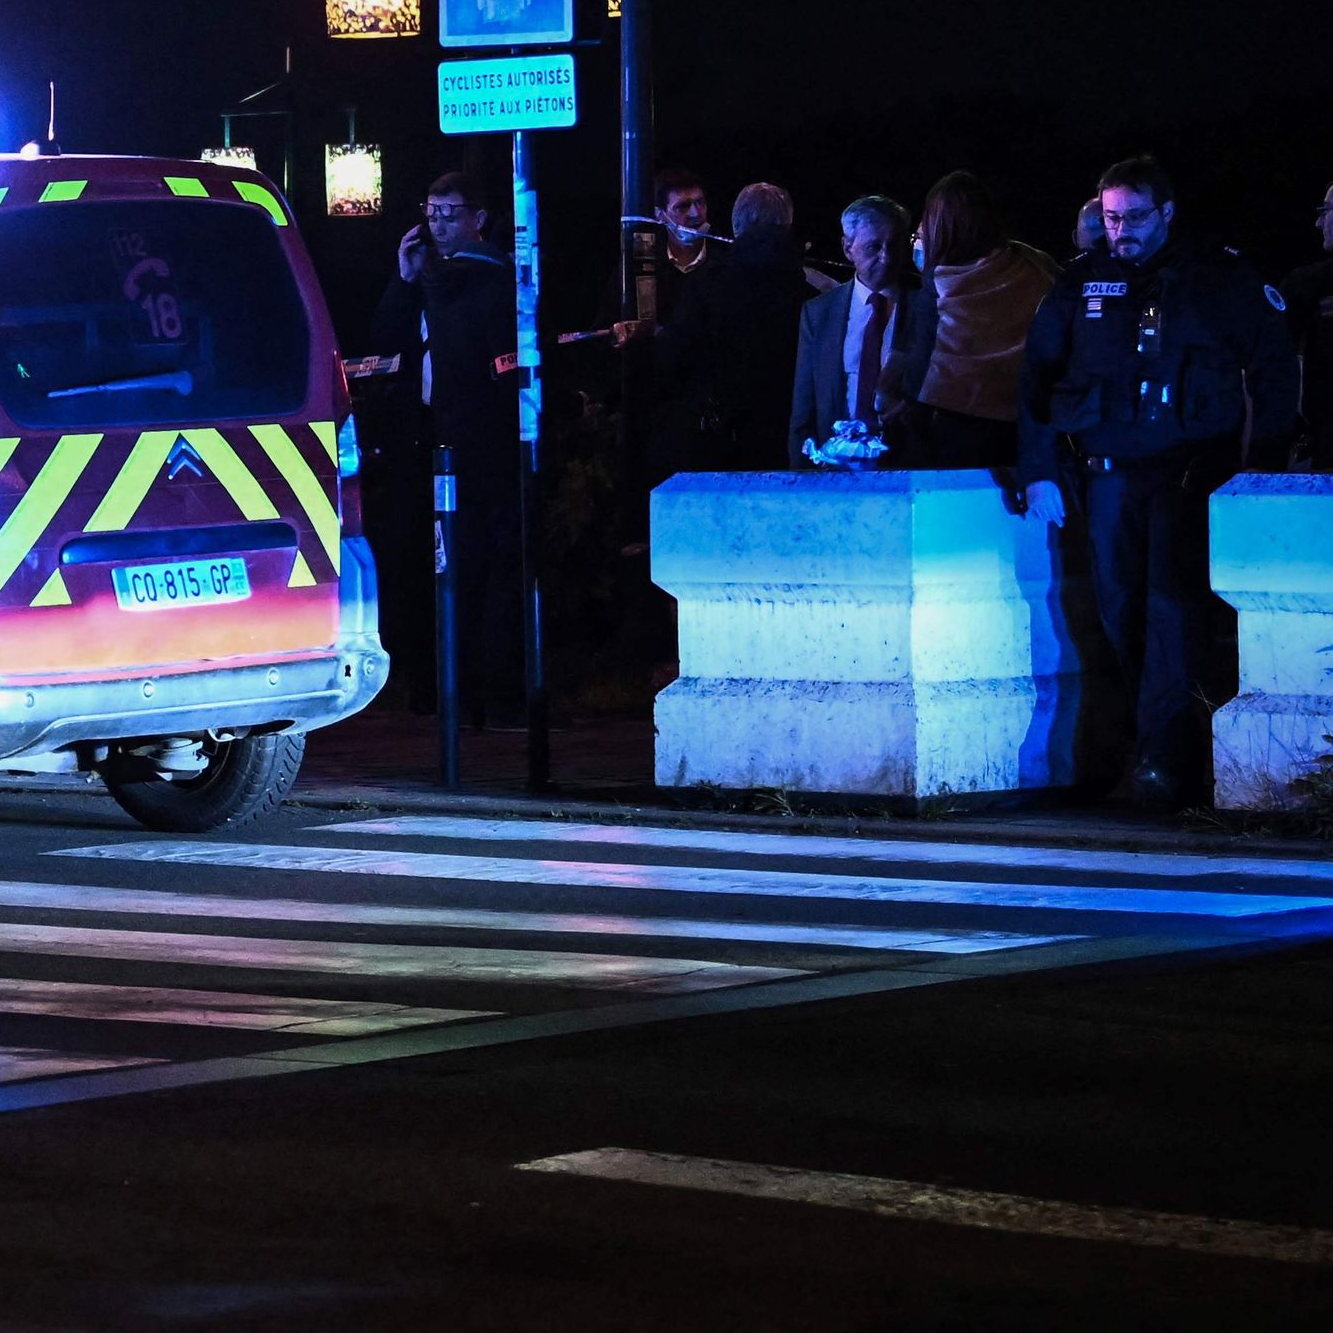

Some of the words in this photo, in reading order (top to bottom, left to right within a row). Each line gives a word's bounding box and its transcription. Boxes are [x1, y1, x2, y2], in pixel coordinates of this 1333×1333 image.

[443, 73, 503, 92] CYCLISTES
[507, 66, 570, 88] AUTORISÉS
[499, 99, 521, 116] AUX
[525, 96, 574, 114] PIÉTONS
[1084, 283, 1127, 294] POLICE
[141, 292, 182, 338] 18
[500, 353, 518, 366] PO
